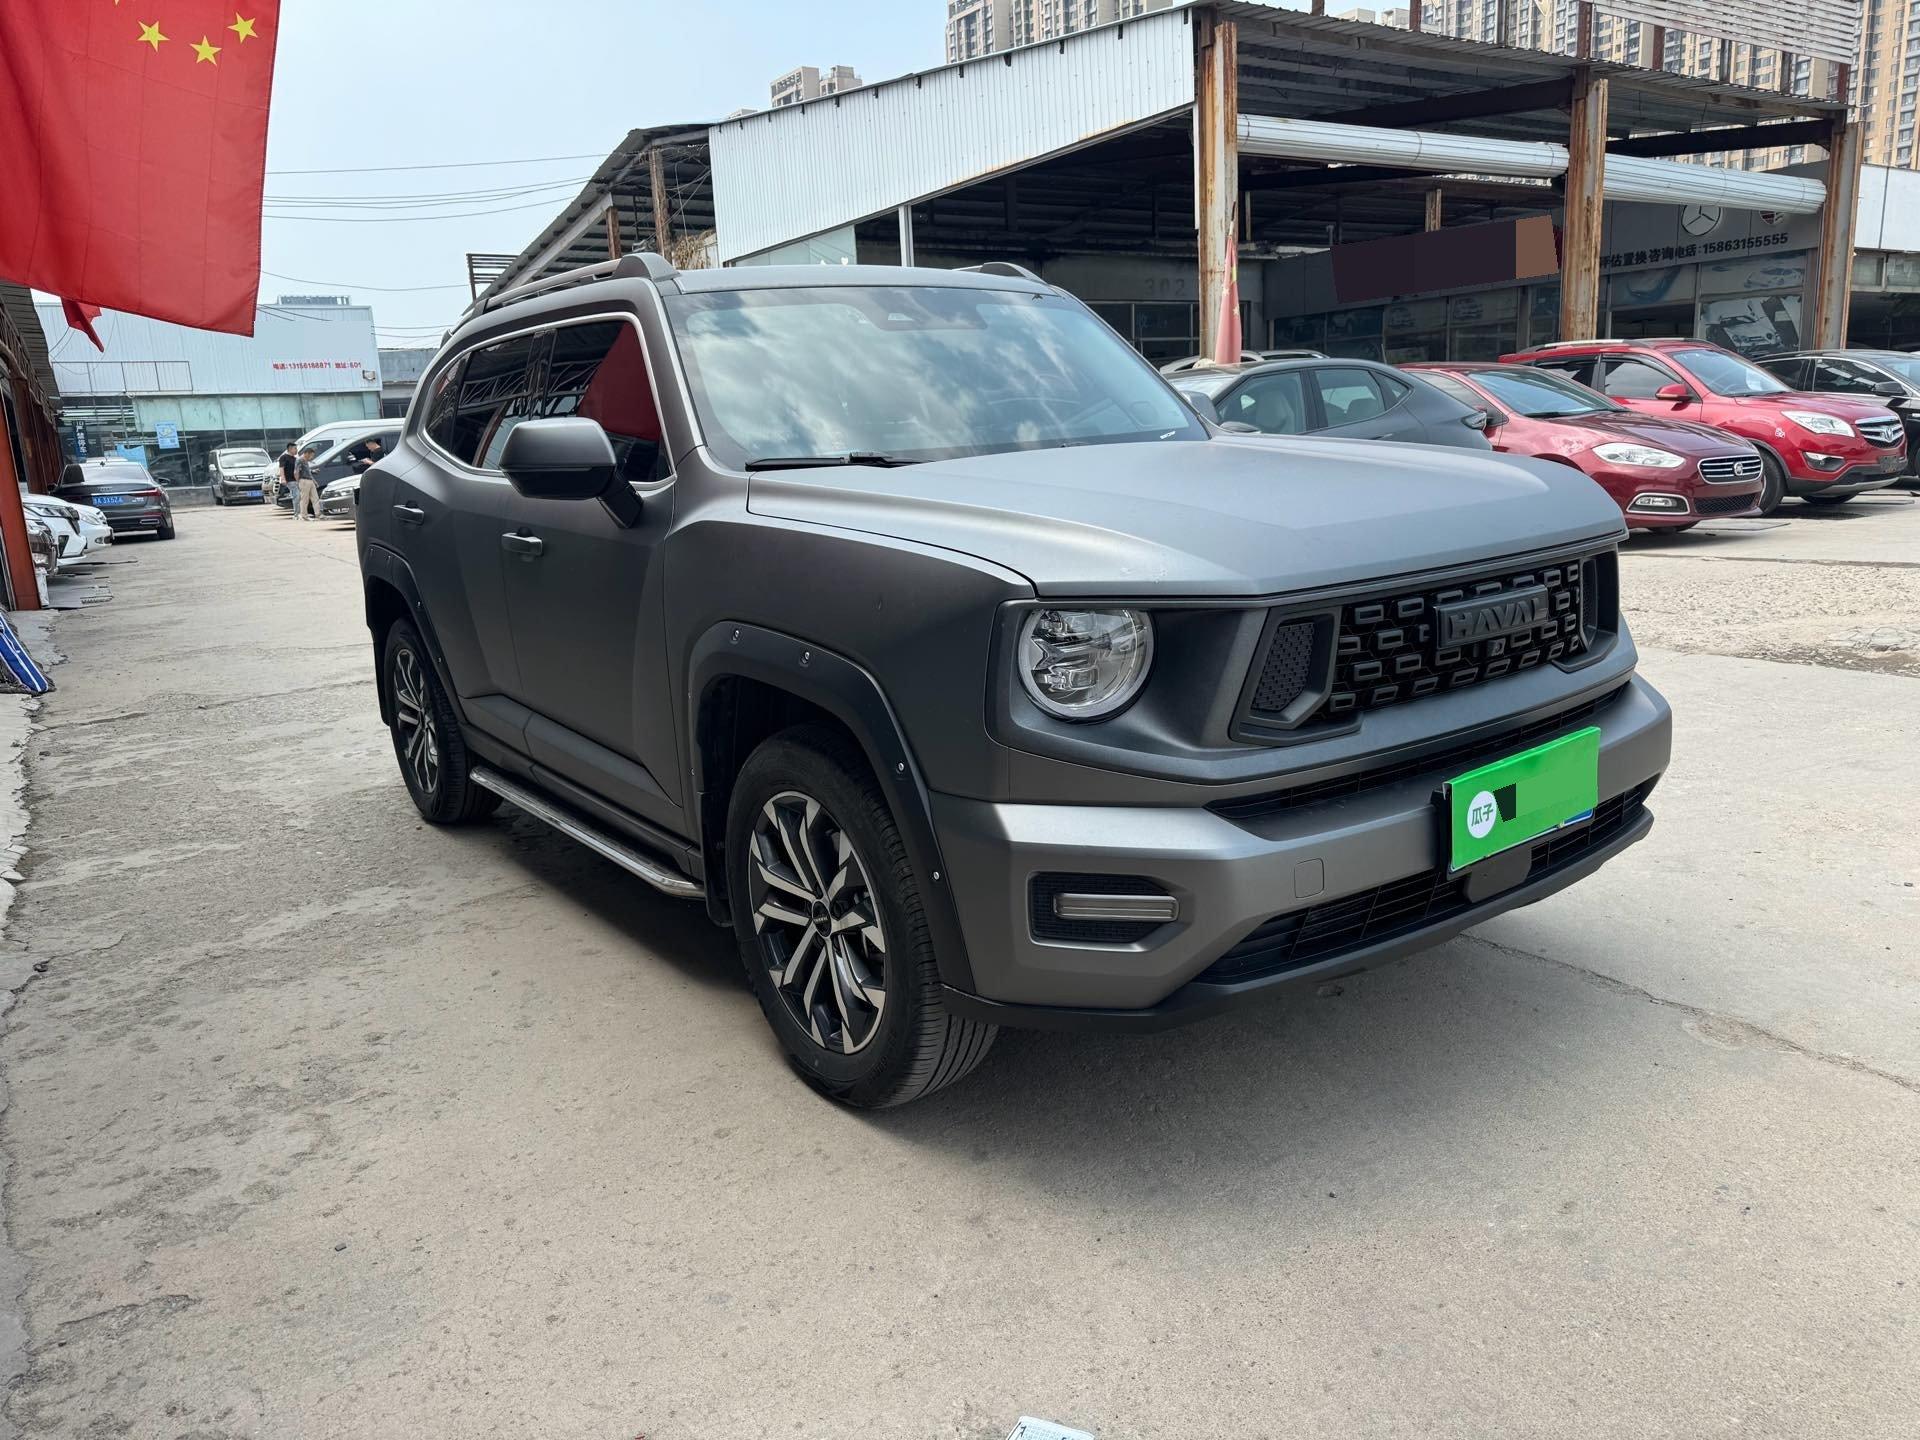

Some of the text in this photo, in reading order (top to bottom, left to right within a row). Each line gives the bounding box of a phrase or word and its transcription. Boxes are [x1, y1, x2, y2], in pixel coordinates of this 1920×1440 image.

[1144, 278, 1186, 297] 302
[1449, 598, 1548, 638] HAVAL
[1471, 802, 1494, 827] 瓜子
